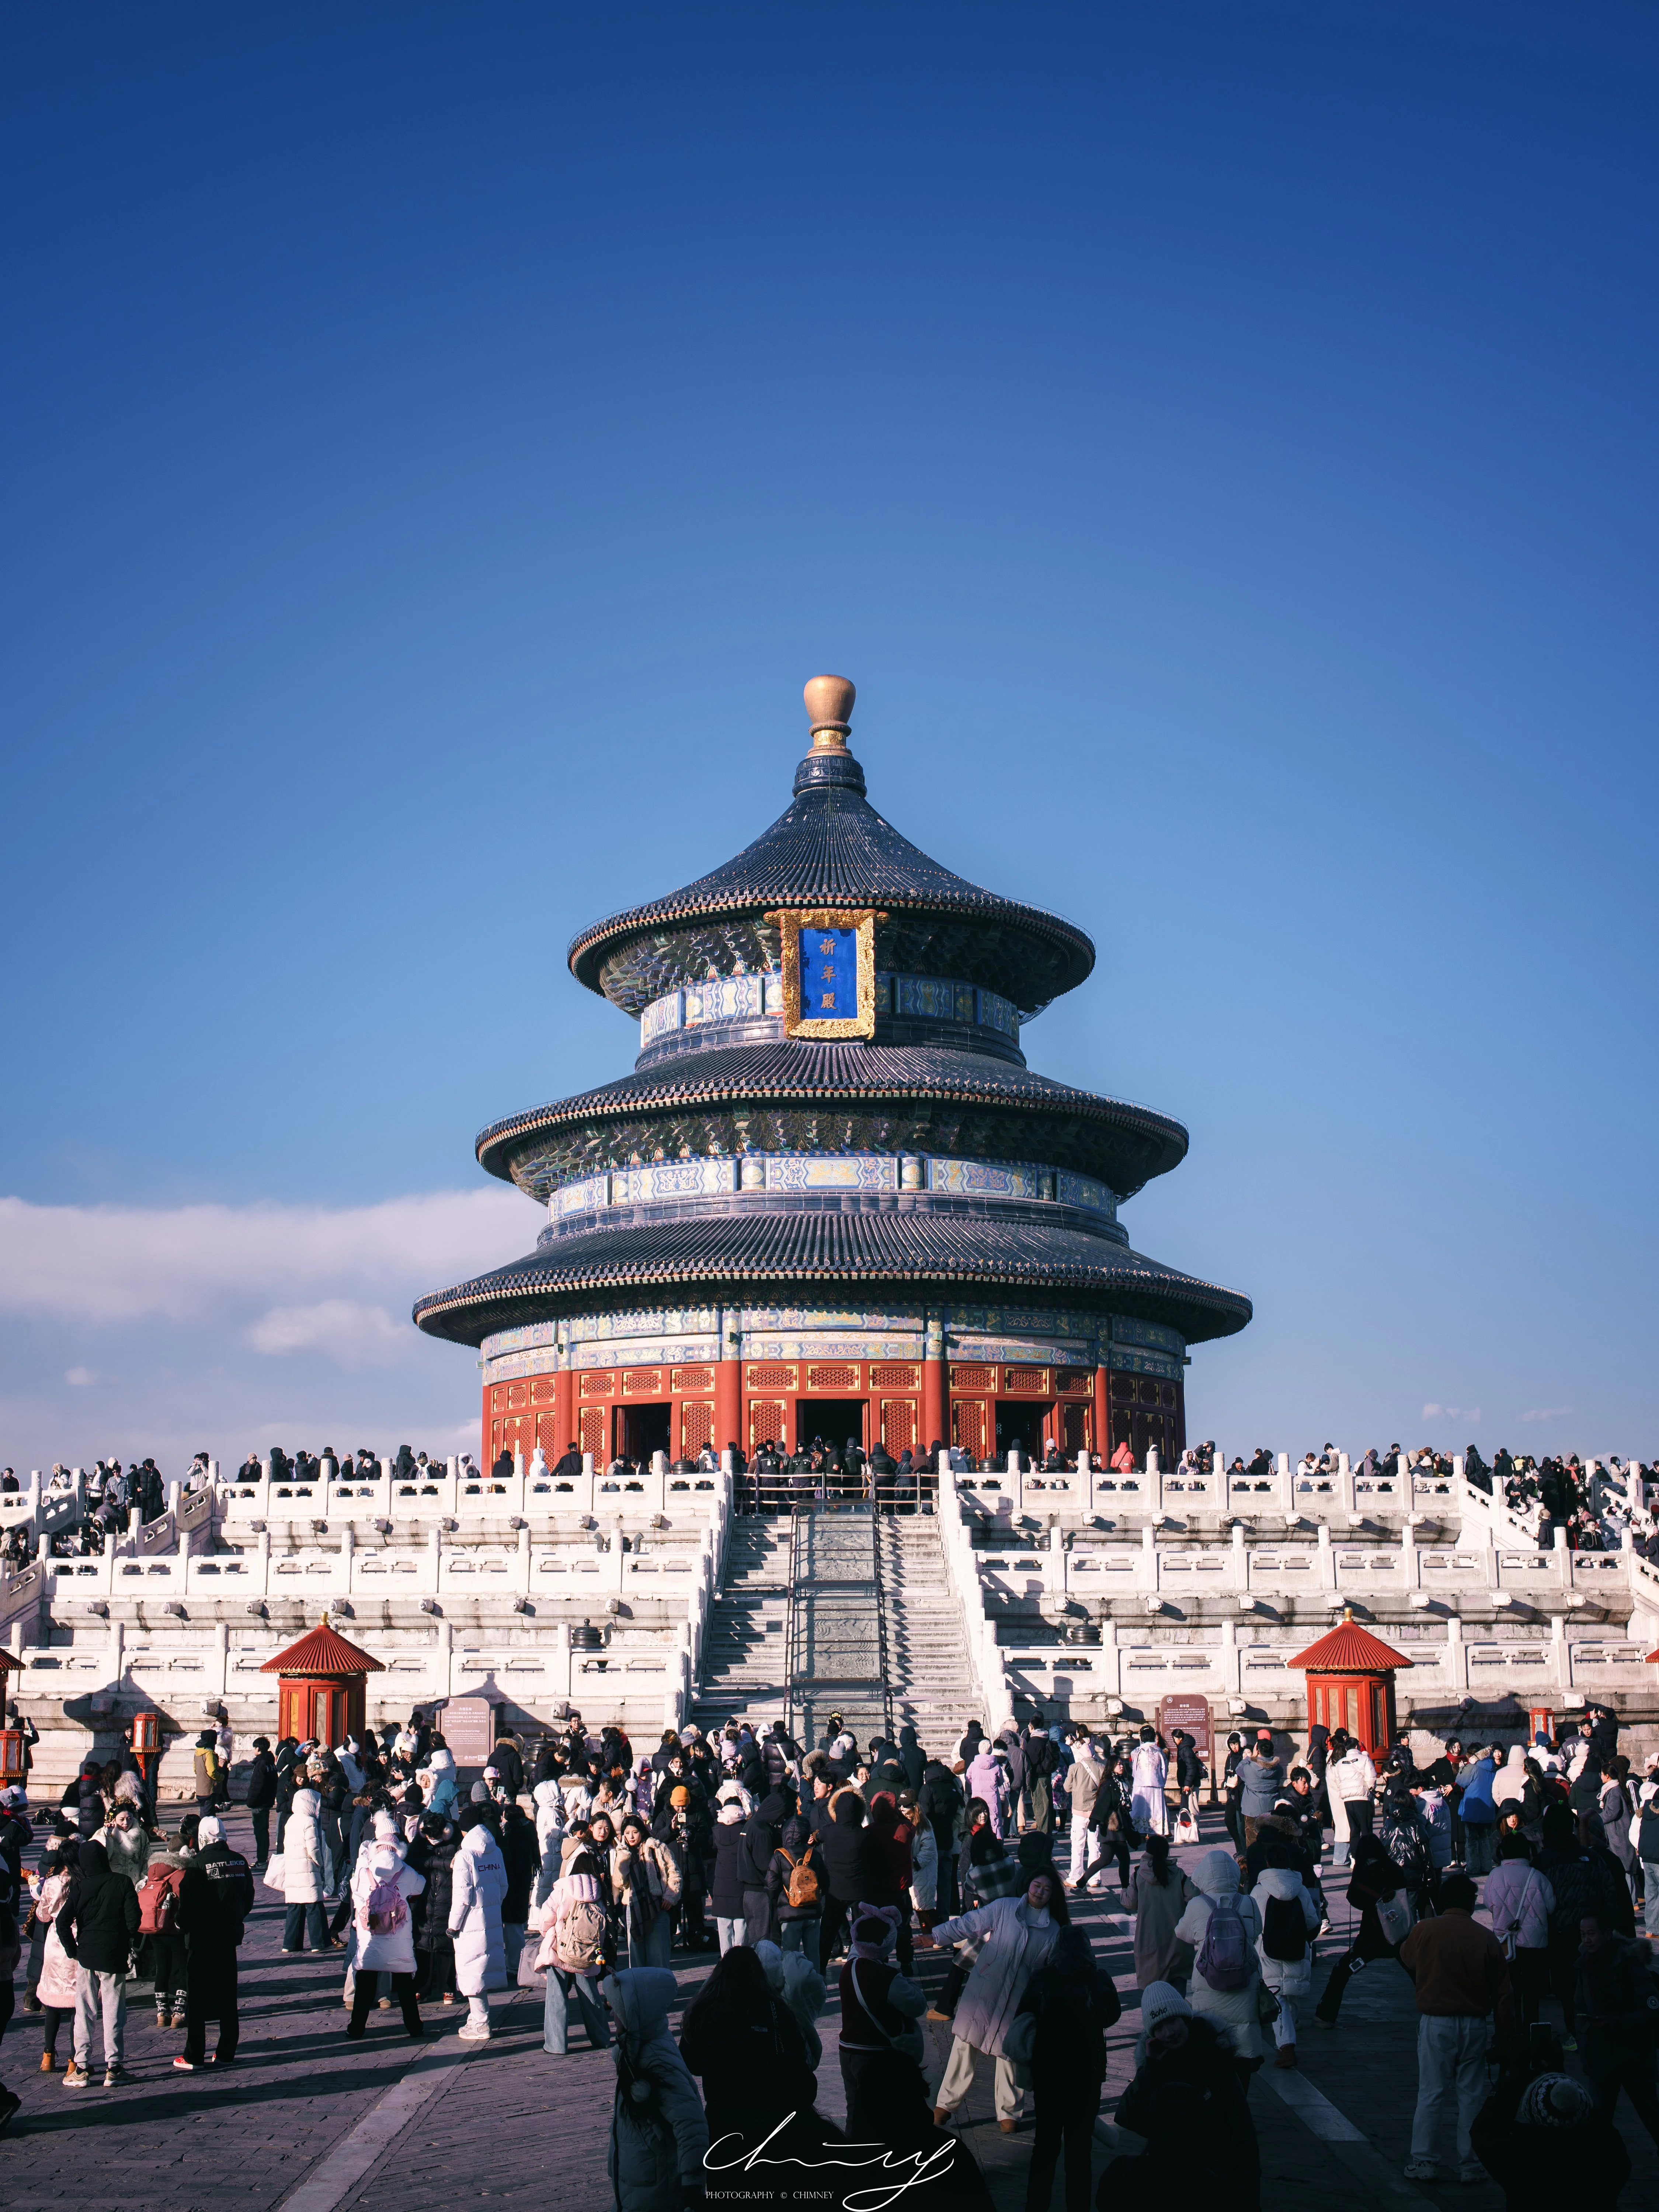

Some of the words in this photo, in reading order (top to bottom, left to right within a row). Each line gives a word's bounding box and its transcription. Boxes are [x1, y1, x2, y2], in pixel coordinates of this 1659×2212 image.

[819, 938, 837, 1010] 祈年殿
[205, 1860, 245, 1869] BATTLEKID
[477, 1863, 501, 1872] CHINA
[1150, 2007, 1167, 2019] Boho
